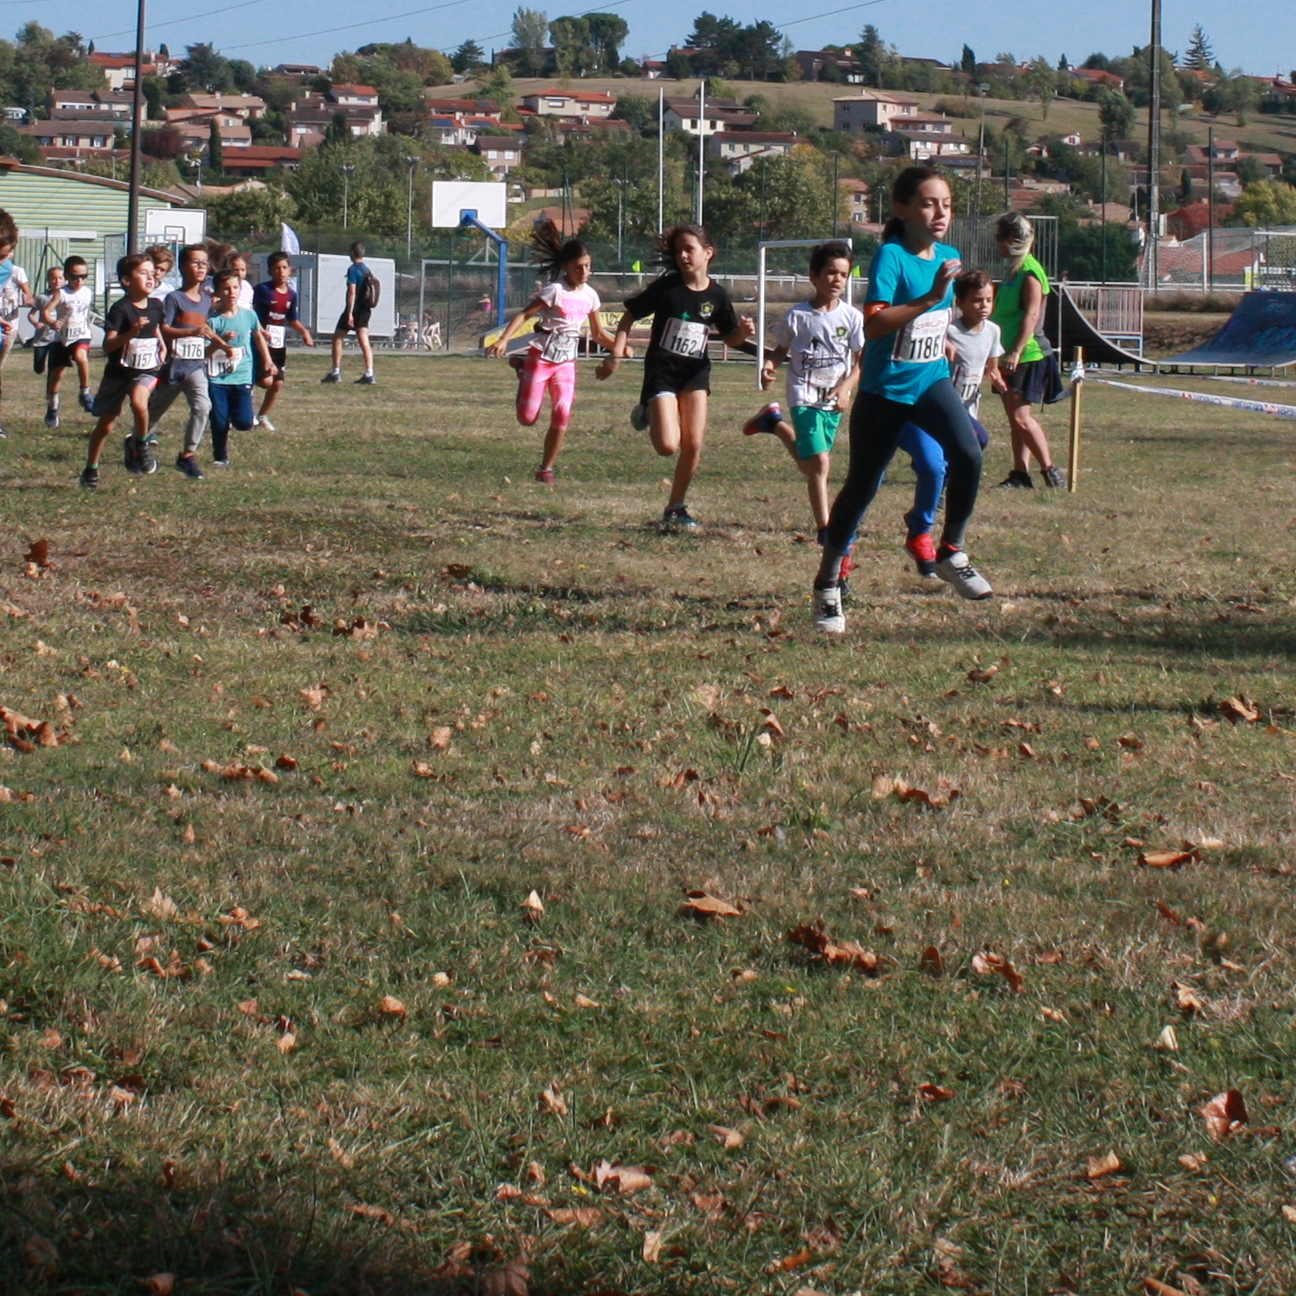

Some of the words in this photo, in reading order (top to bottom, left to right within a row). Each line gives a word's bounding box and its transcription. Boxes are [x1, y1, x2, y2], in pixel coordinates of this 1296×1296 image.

[181, 344, 203, 357] 1176
[909, 334, 942, 360] 1186
[133, 353, 153, 367] 1157
